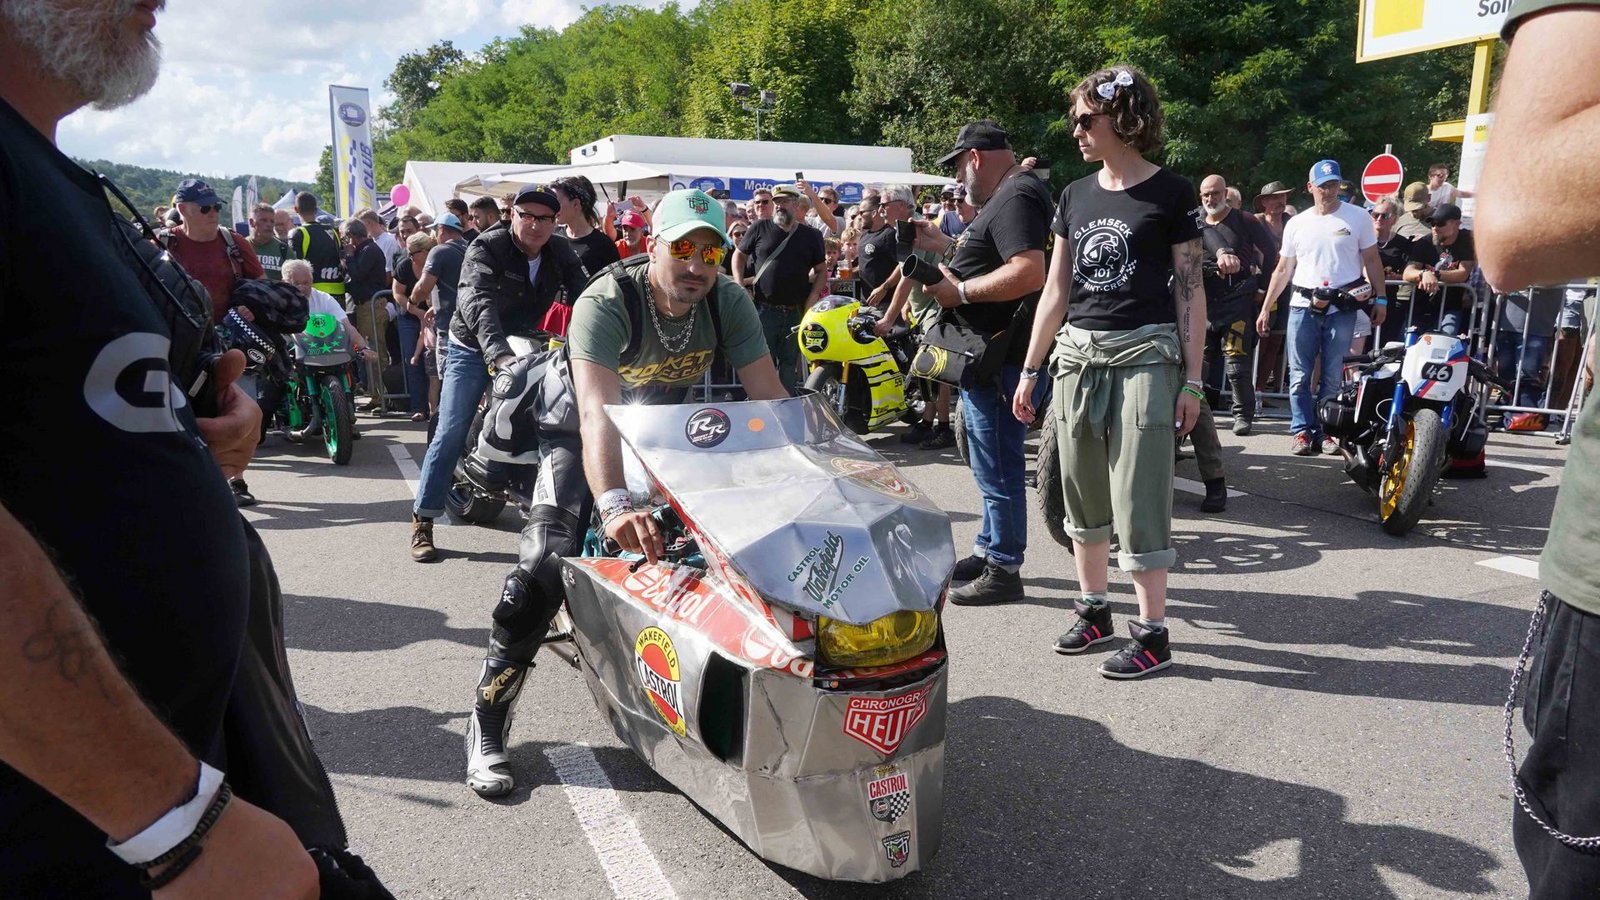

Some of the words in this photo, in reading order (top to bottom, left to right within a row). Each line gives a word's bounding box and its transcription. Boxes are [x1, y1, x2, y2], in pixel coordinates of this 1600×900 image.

[360, 142, 375, 190] CLUB
[744, 180, 775, 191] Moto
[1074, 218, 1133, 239] GLEMSECK
[256, 254, 281, 266] TORY
[1093, 268, 1111, 278] 101
[1425, 364, 1449, 381] 46
[787, 546, 822, 583] CASTROL
[802, 530, 844, 602] Wakefield
[822, 573, 855, 610] MOTOR
[853, 555, 870, 573] OIL
[638, 630, 676, 669] WAKEFIELD
[637, 656, 683, 719] CASTROL
[869, 775, 907, 798] CASTROL
